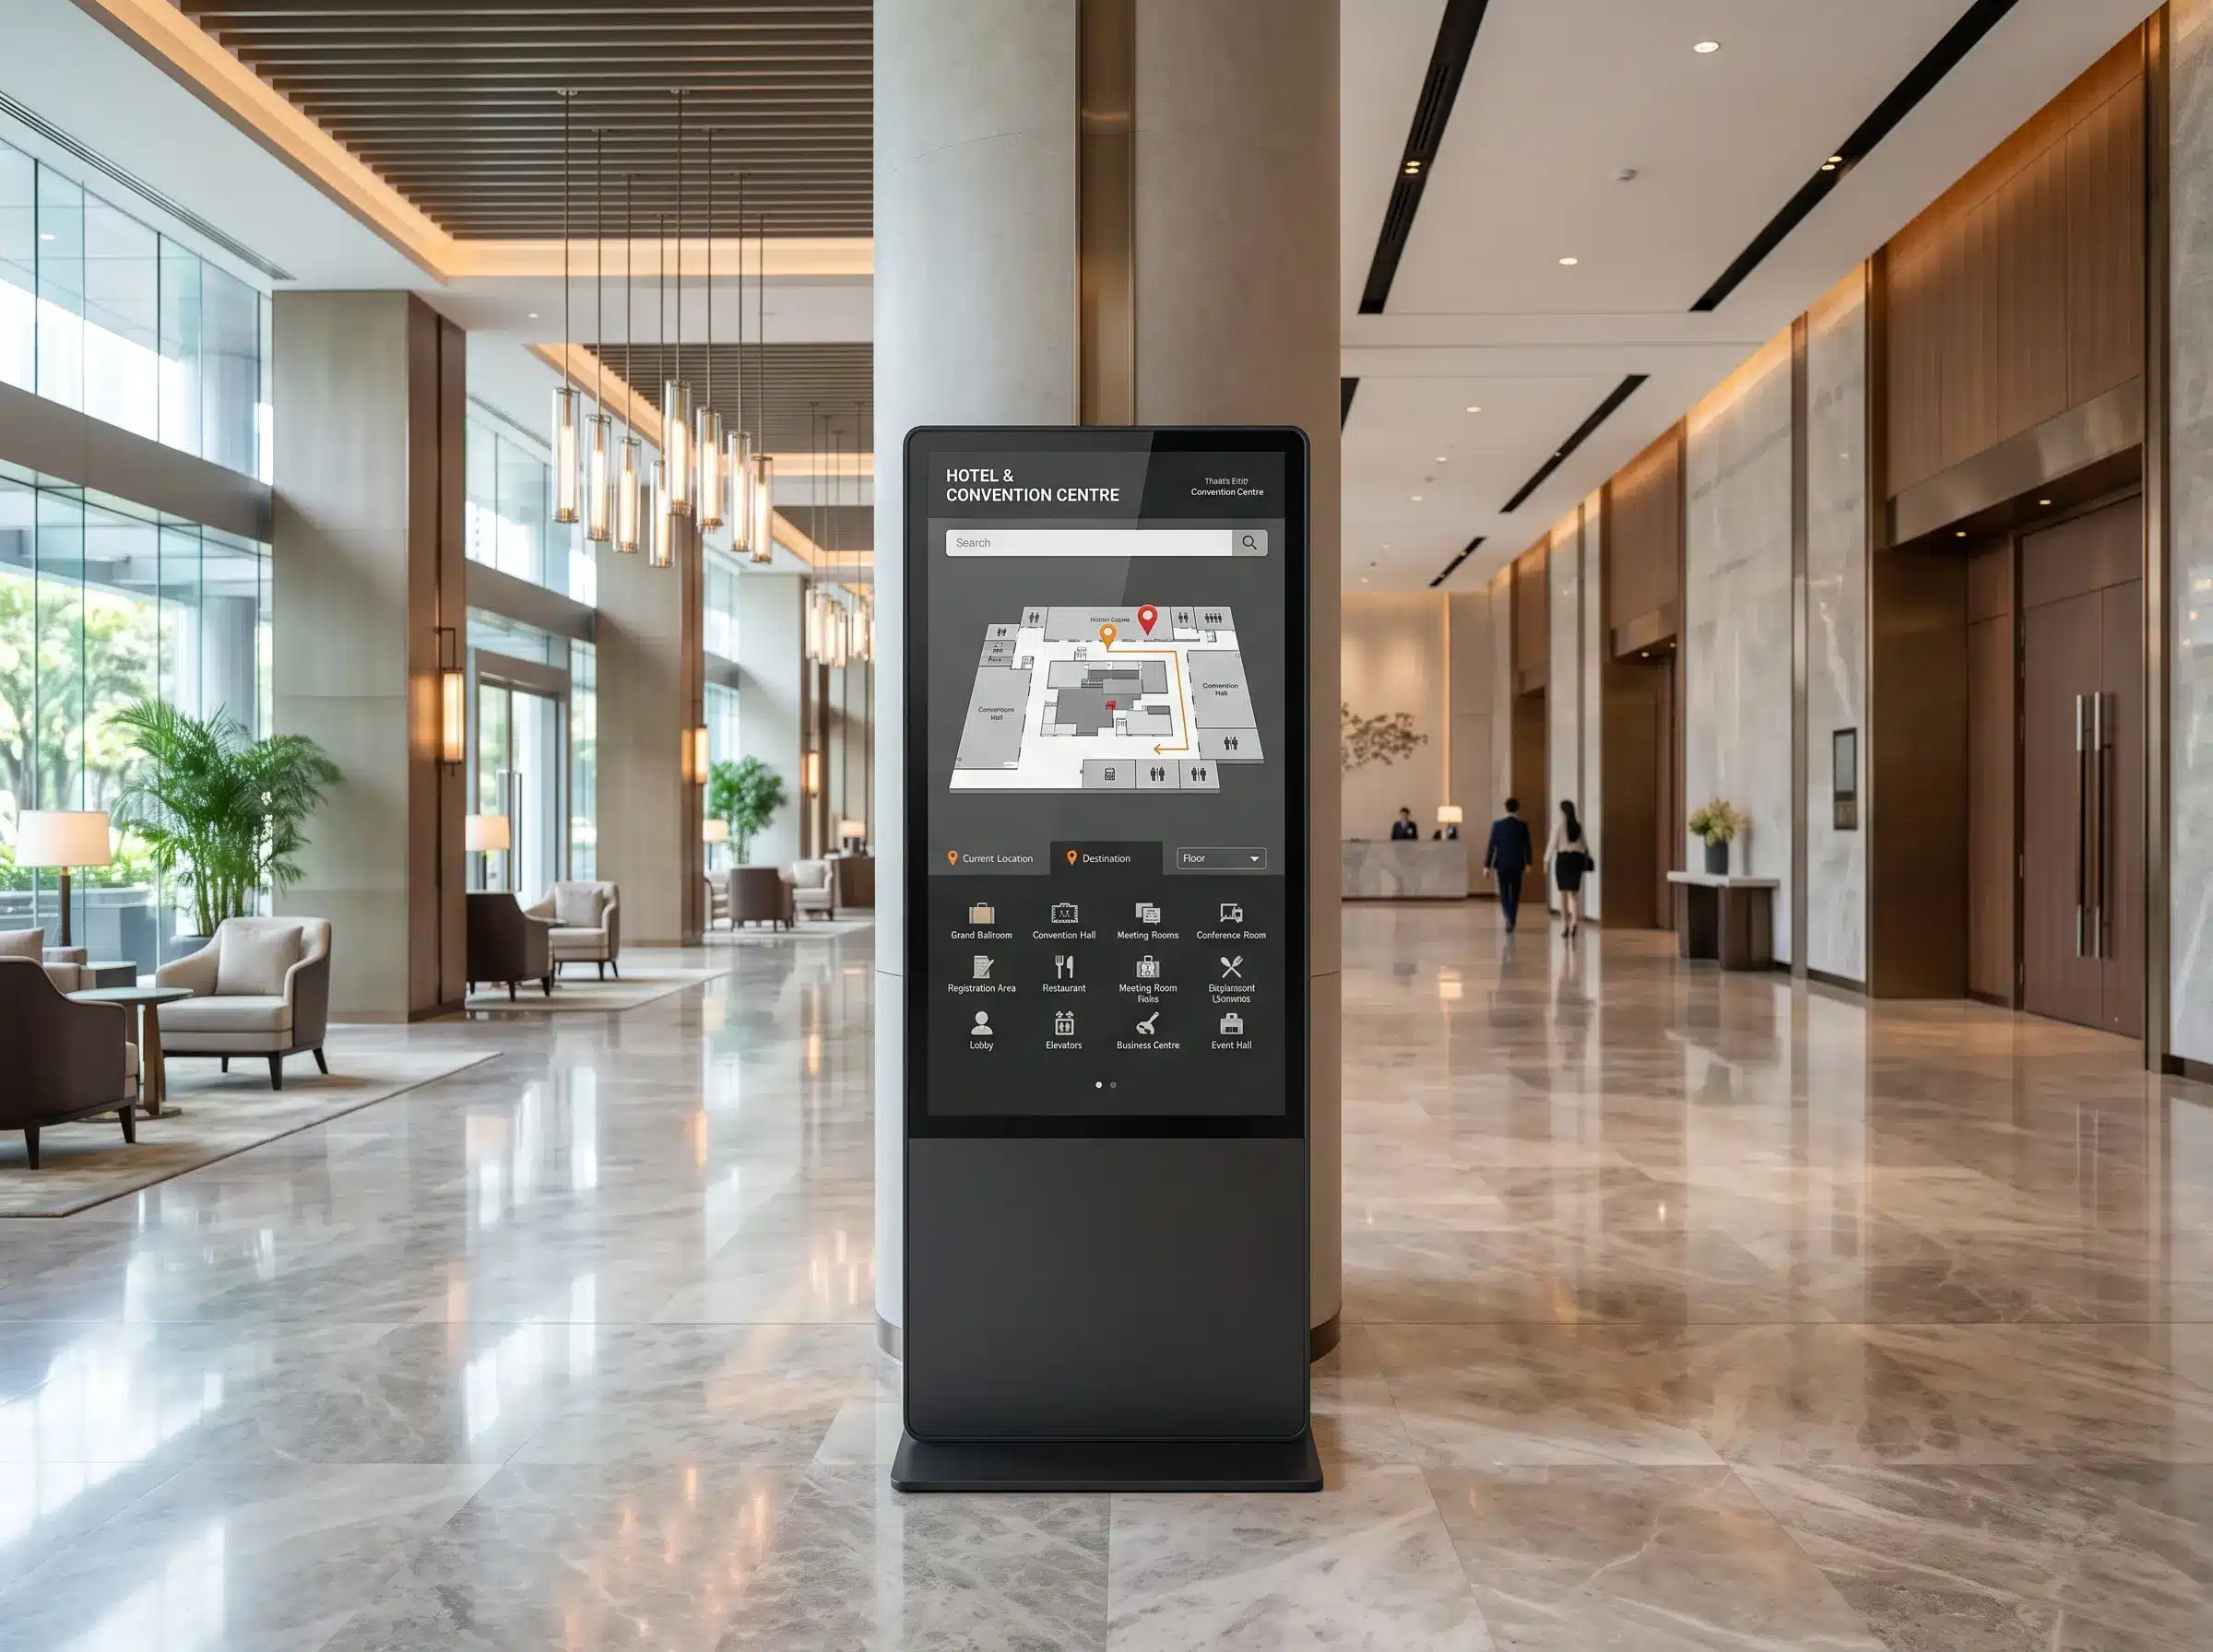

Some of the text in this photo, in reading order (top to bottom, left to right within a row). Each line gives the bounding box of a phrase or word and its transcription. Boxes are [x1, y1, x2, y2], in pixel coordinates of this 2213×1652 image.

[946, 468, 1014, 482] HOTEL &
[946, 488, 1120, 502] CONVENTION CENTRE
[1190, 488, 1264, 496] Convention Centre
[956, 538, 991, 548] Search
[963, 854, 1034, 864] Current Location
[1083, 854, 1131, 864] Destination
[1183, 854, 1206, 864] Floor
[951, 930, 975, 940] Grand
[1033, 930, 1096, 940] Convention Hall
[1117, 930, 1179, 942] Meeting Rooms
[1196, 930, 1267, 940] Conference Room
[948, 984, 1016, 995] Registration Area
[1042, 984, 1086, 993] Restaurant
[1118, 984, 1178, 995] Meeting Room
[969, 1041, 994, 1052] Lobby
[1046, 1041, 1083, 1050] Elevators
[1117, 1041, 1180, 1050] Business Centre
[1211, 1041, 1252, 1050] Event Hall
